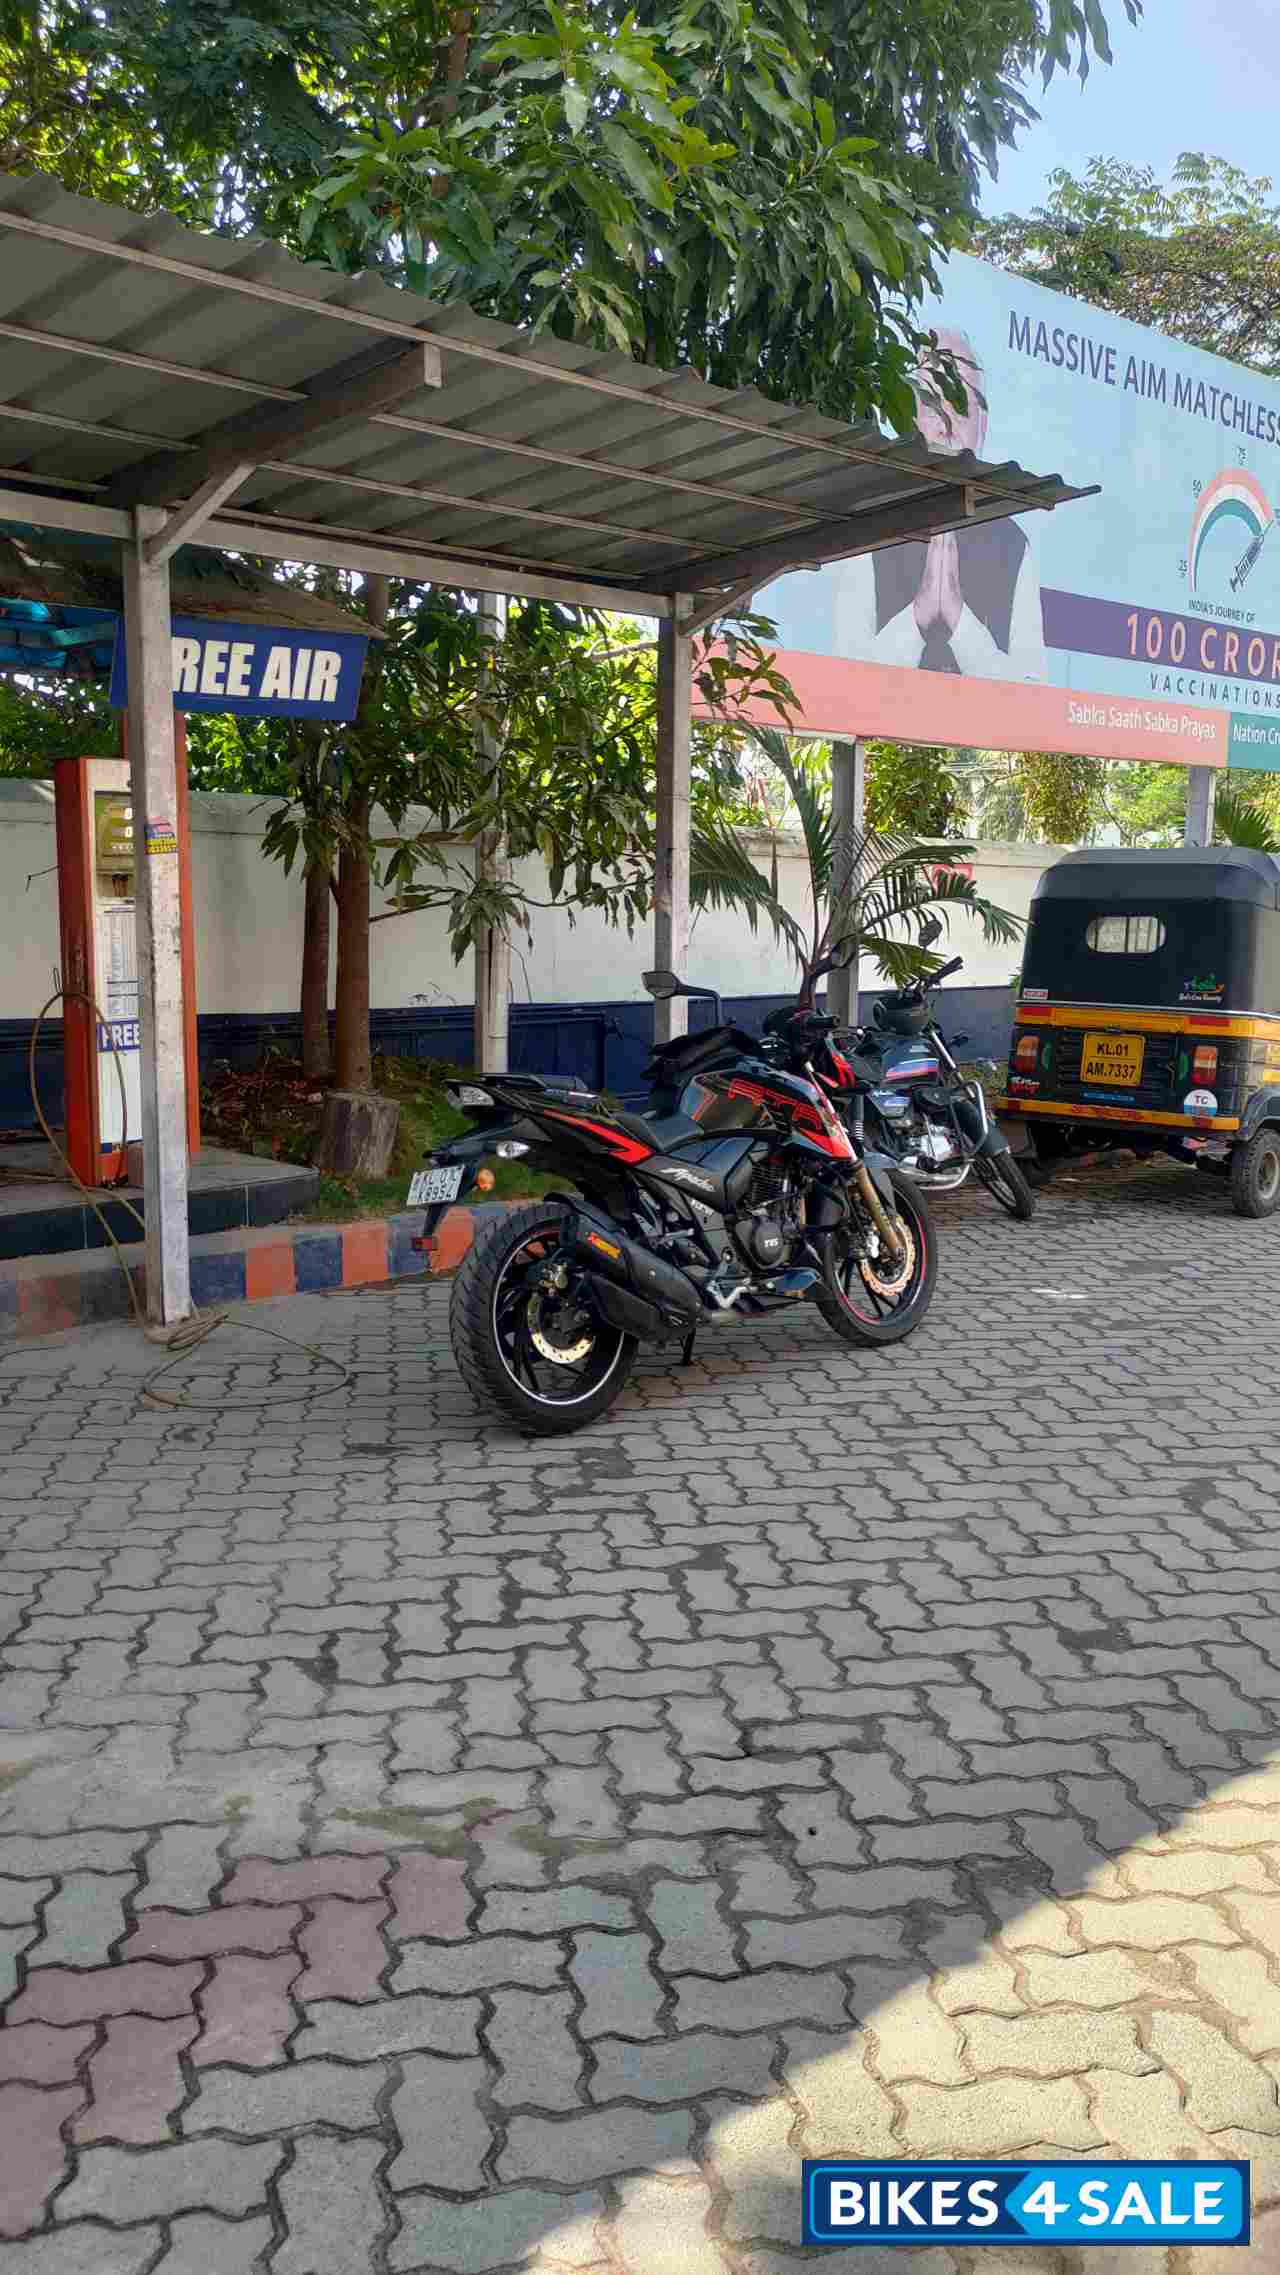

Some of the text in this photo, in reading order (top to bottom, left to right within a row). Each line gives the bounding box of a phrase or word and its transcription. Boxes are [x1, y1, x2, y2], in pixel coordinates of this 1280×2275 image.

[1008, 310, 1116, 386] MASSIVE
[1123, 355, 1167, 404] AIM
[1246, 611, 1256, 622] OF
[1127, 613, 1186, 663] 100
[172, 637, 341, 702] REE AIR
[1069, 702, 1216, 742] Sabka Saath Sabka Prayas
[1233, 724, 1266, 744] Nation
[1195, 1096, 1209, 1105] TC
